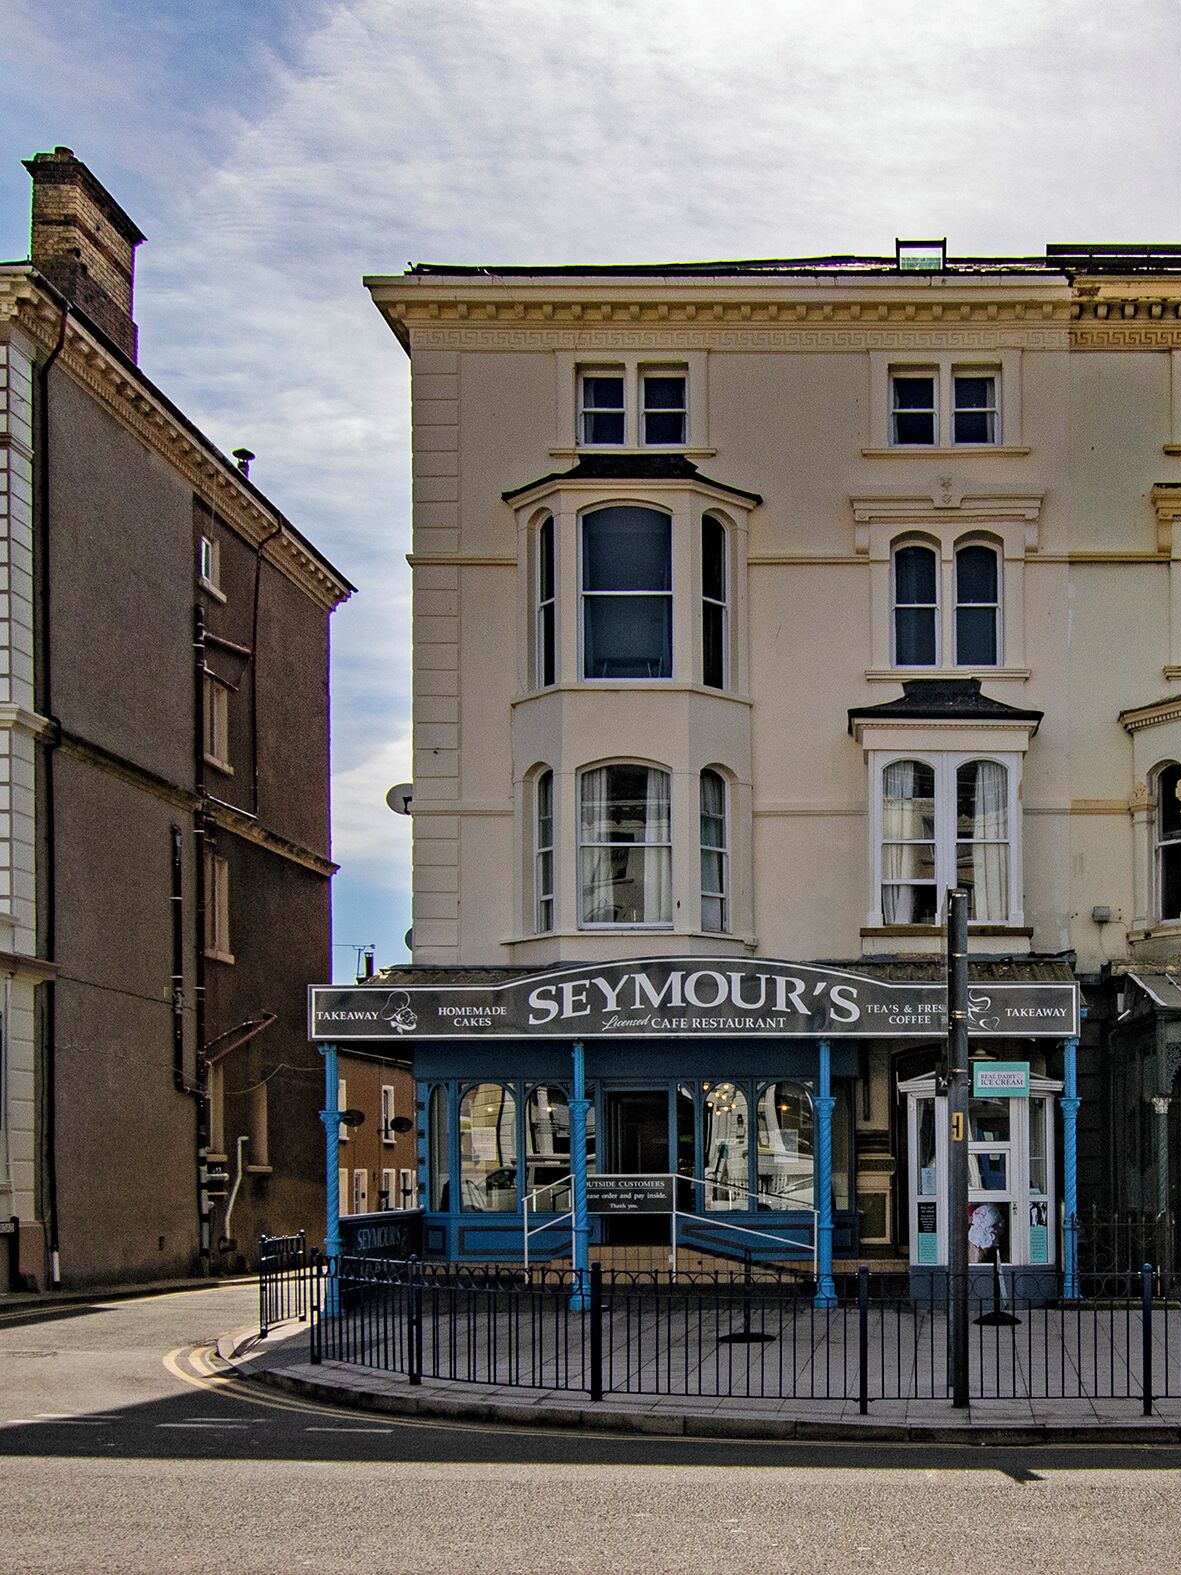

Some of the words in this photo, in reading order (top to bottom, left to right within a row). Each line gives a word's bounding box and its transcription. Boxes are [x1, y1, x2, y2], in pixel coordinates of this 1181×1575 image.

[528, 971, 861, 1025] SEYMOUR'S
[438, 1007, 507, 1016] HOMEMADE
[866, 1004, 899, 1013] TEA'S
[903, 1005, 913, 1013] &
[918, 1004, 944, 1013] FRES
[1005, 1008, 1067, 1017] TAKEAWAY
[316, 1011, 379, 1020] TAKEAWAY
[888, 1015, 932, 1024] COFFEE
[453, 1018, 492, 1027] CAKES
[601, 1014, 651, 1031] Licensed
[651, 1018, 688, 1029] CAFE
[692, 1017, 787, 1028] RESTAURANT
